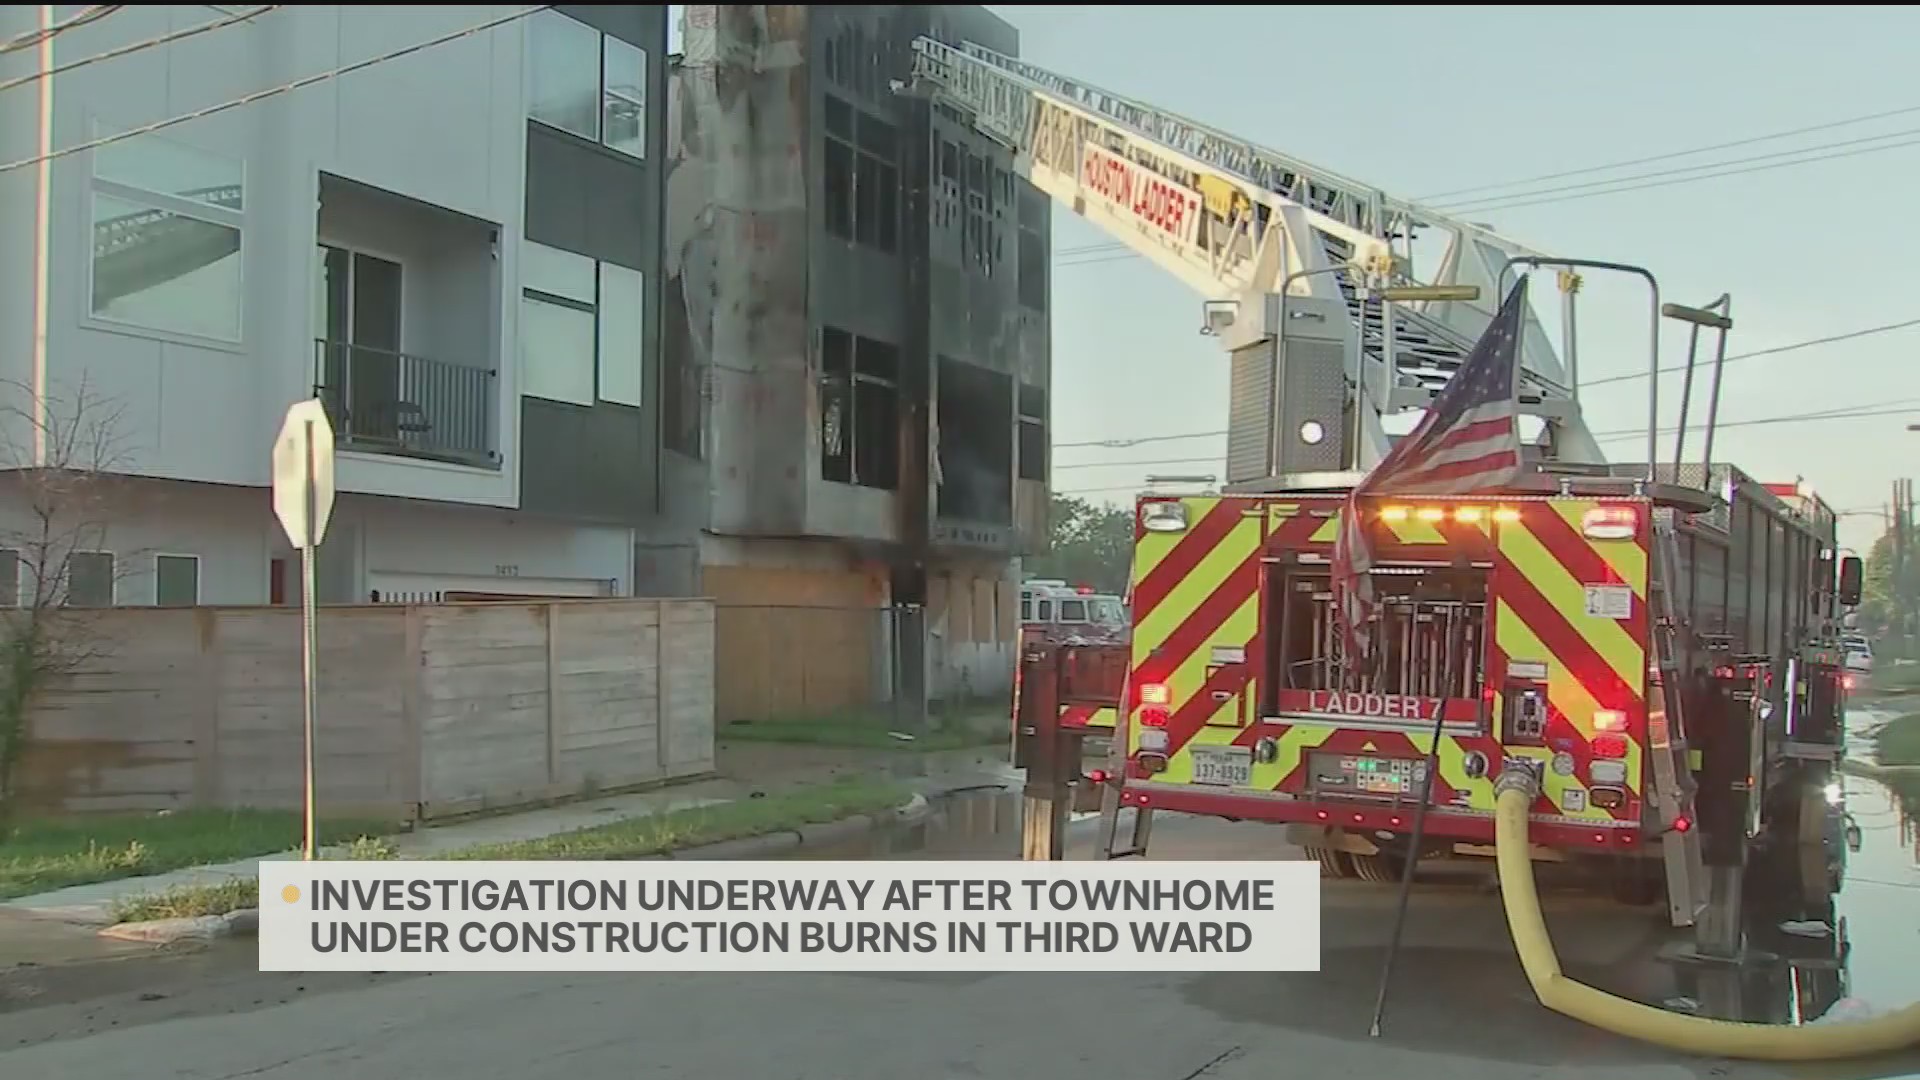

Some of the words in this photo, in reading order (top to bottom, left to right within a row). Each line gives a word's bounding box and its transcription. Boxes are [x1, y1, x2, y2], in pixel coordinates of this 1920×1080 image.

[1083, 151, 1133, 208] HOUSTON
[1133, 172, 1185, 237] LADDER
[1185, 200, 1197, 242] 7
[1309, 689, 1421, 718] LADDER
[1426, 698, 1443, 719] 7
